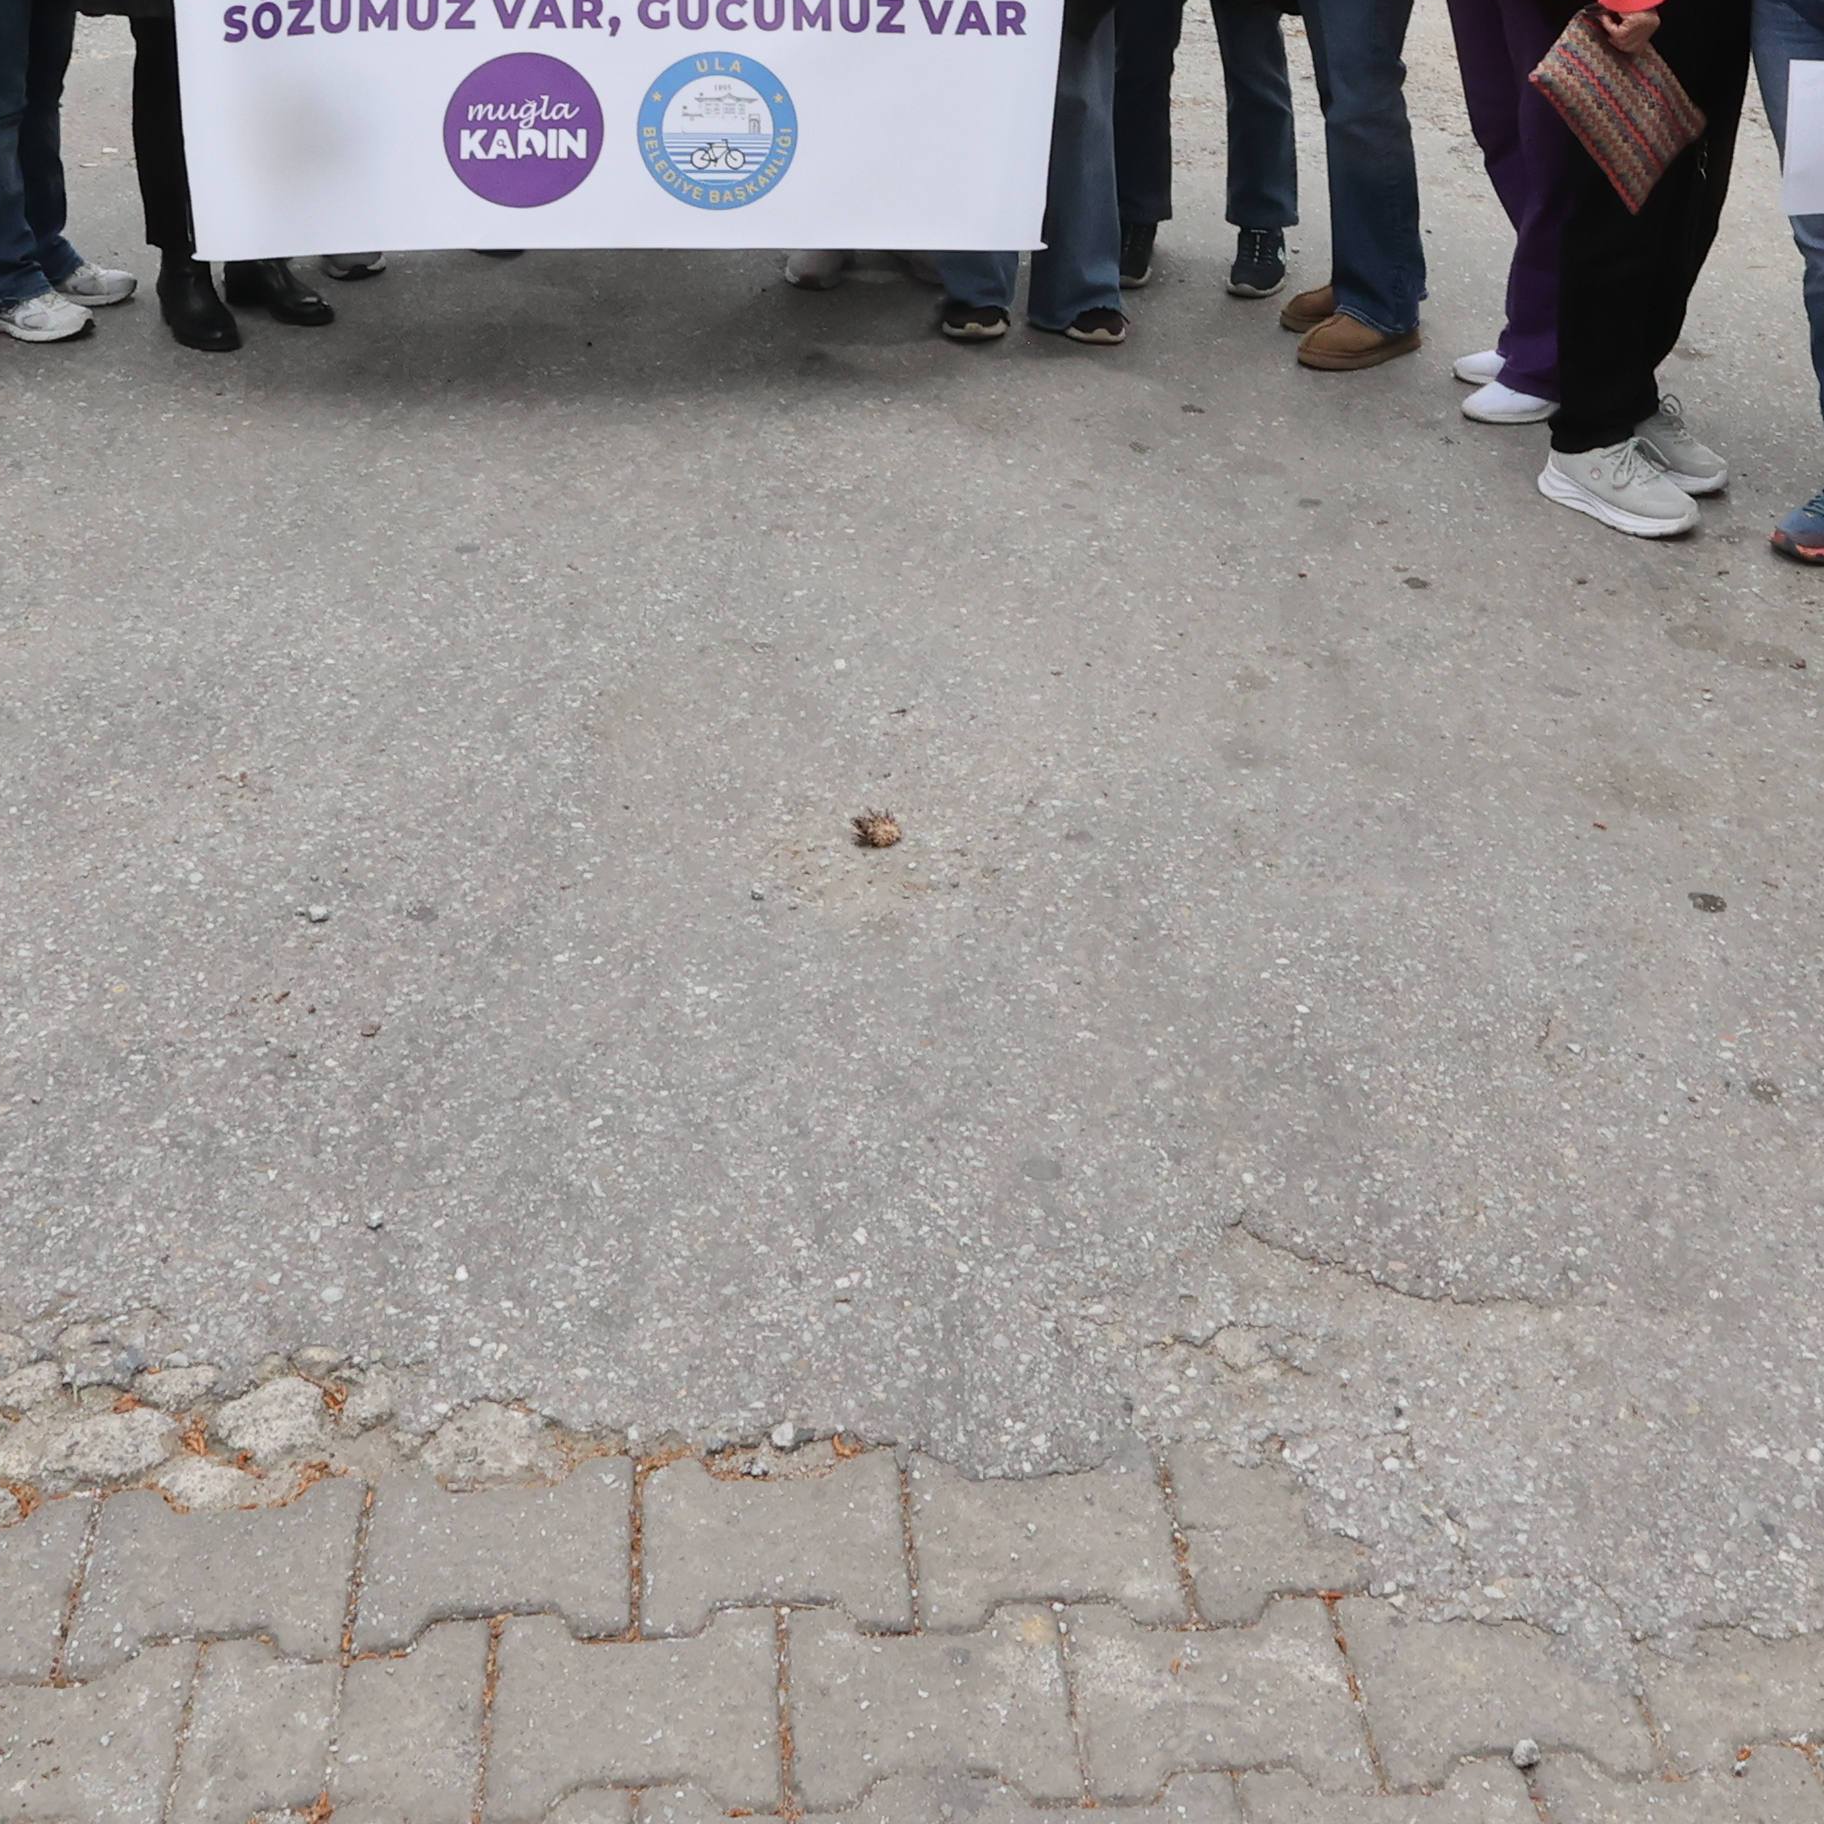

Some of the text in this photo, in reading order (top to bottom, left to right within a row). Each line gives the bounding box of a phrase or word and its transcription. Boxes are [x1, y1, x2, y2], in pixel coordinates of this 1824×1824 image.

[918, 0, 1027, 36] VAR
[696, 57, 743, 73] ULA
[467, 94, 581, 129] muğla
[459, 128, 588, 160] KADIN
[643, 126, 793, 204] BELEDİYE BAŞKANLIĞI
